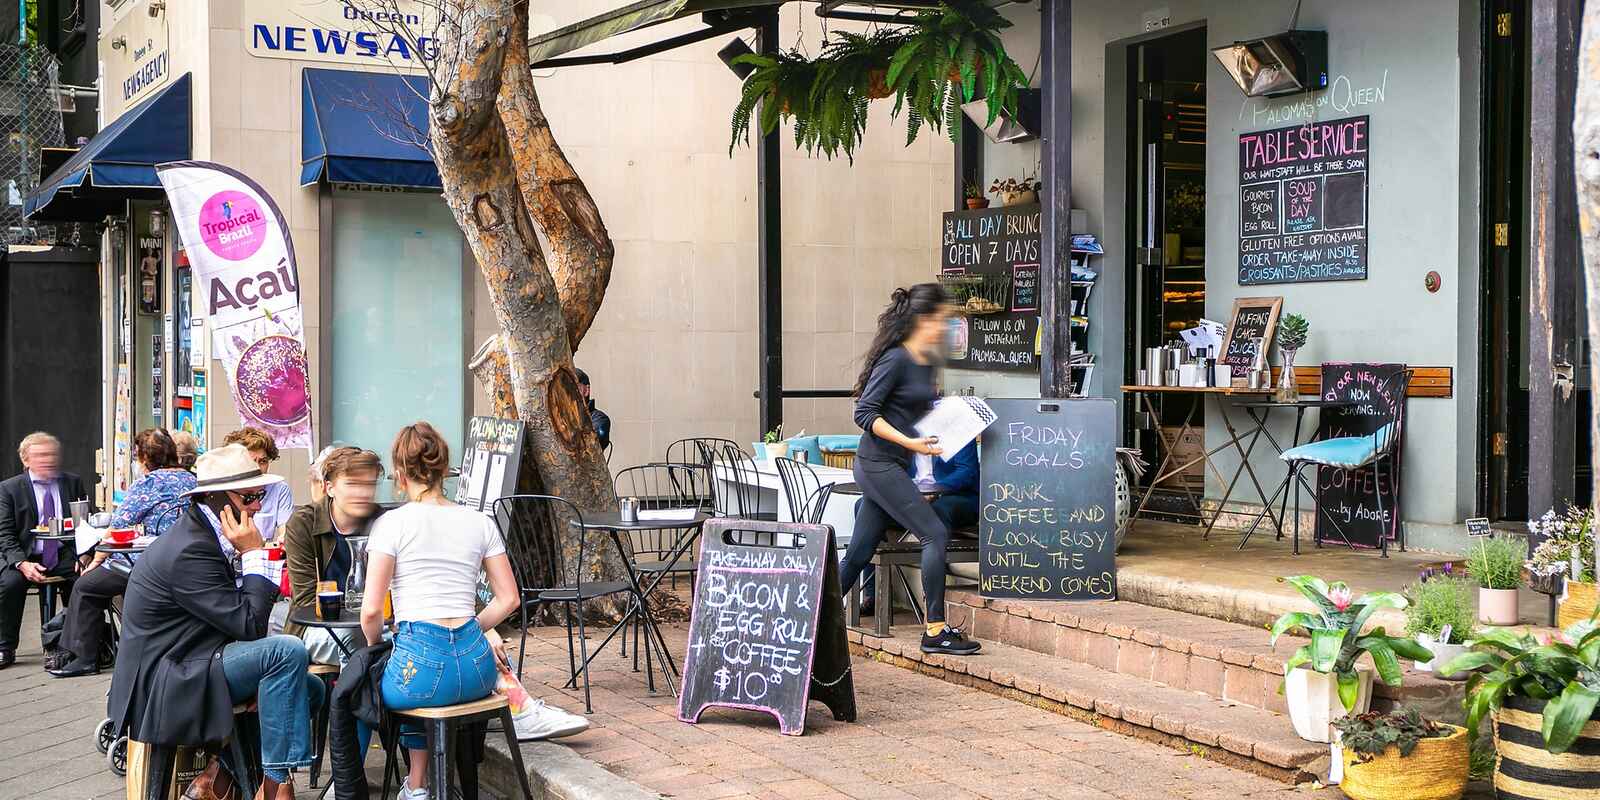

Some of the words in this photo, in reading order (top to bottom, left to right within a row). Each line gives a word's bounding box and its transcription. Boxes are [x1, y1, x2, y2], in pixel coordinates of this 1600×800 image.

[343, 6, 419, 25] Queen
[123, 49, 168, 101] NEWSAGENCY
[1332, 68, 1388, 113] QUEEN
[1240, 129, 1298, 169] TABLE
[1299, 121, 1368, 160] SERVICE
[1243, 171, 1257, 181] OUR
[1296, 165, 1311, 175] WILL
[1313, 163, 1323, 172] BE
[1346, 158, 1365, 169] SOON
[1243, 189, 1275, 202] GOURMET
[1288, 181, 1317, 199] SOUP
[1251, 202, 1273, 214] BACON
[1291, 203, 1310, 218] DAY
[203, 209, 262, 236] Tropical
[956, 218, 974, 238] ALL
[979, 215, 1003, 237] DAY
[1006, 212, 1042, 235] BRUNC
[1244, 222, 1258, 232] EGG
[1261, 220, 1277, 230] ROLL
[219, 226, 253, 244] Brazil
[1241, 239, 1281, 252] GLUTEN
[1284, 235, 1304, 248] FREE
[1310, 232, 1341, 246] OPTIONS
[949, 242, 981, 265] OPEN
[988, 241, 999, 264] 7
[1005, 239, 1038, 263] DAYS
[1242, 254, 1271, 266] ORDER
[1273, 250, 1322, 264] TAKE-AWAY
[1327, 244, 1360, 260] INSIDE
[209, 257, 297, 316] Açaí
[974, 317, 1000, 331] FOLLOW
[1003, 318, 1012, 331] US
[1014, 319, 1026, 332] ON
[1236, 312, 1270, 326] MUFFINS
[1235, 327, 1257, 340] CAKE
[1357, 371, 1376, 385] NEW
[1350, 388, 1370, 401] NOW
[1008, 422, 1083, 448] FRIDAY
[1005, 449, 1084, 470] GOALS
[1320, 465, 1390, 496] COFFEE
[988, 483, 1053, 502] DRINK
[983, 503, 1057, 525] COFFEE
[1069, 505, 1105, 523] AND
[1355, 503, 1391, 522] ADORE
[987, 528, 1048, 549] LOOK
[1060, 530, 1108, 552] BUSY
[706, 550, 777, 569] TAKE-AWAY
[783, 554, 818, 576] ONLY
[987, 552, 1040, 568] UNTIL
[1048, 552, 1085, 570] THE
[706, 572, 789, 613] BACON
[796, 583, 811, 611] &
[981, 575, 1052, 594] WEEKEND
[1060, 572, 1112, 595] COMES
[717, 611, 765, 636] EGG
[772, 617, 813, 645] ROLL
[723, 638, 802, 675] COFFEE
